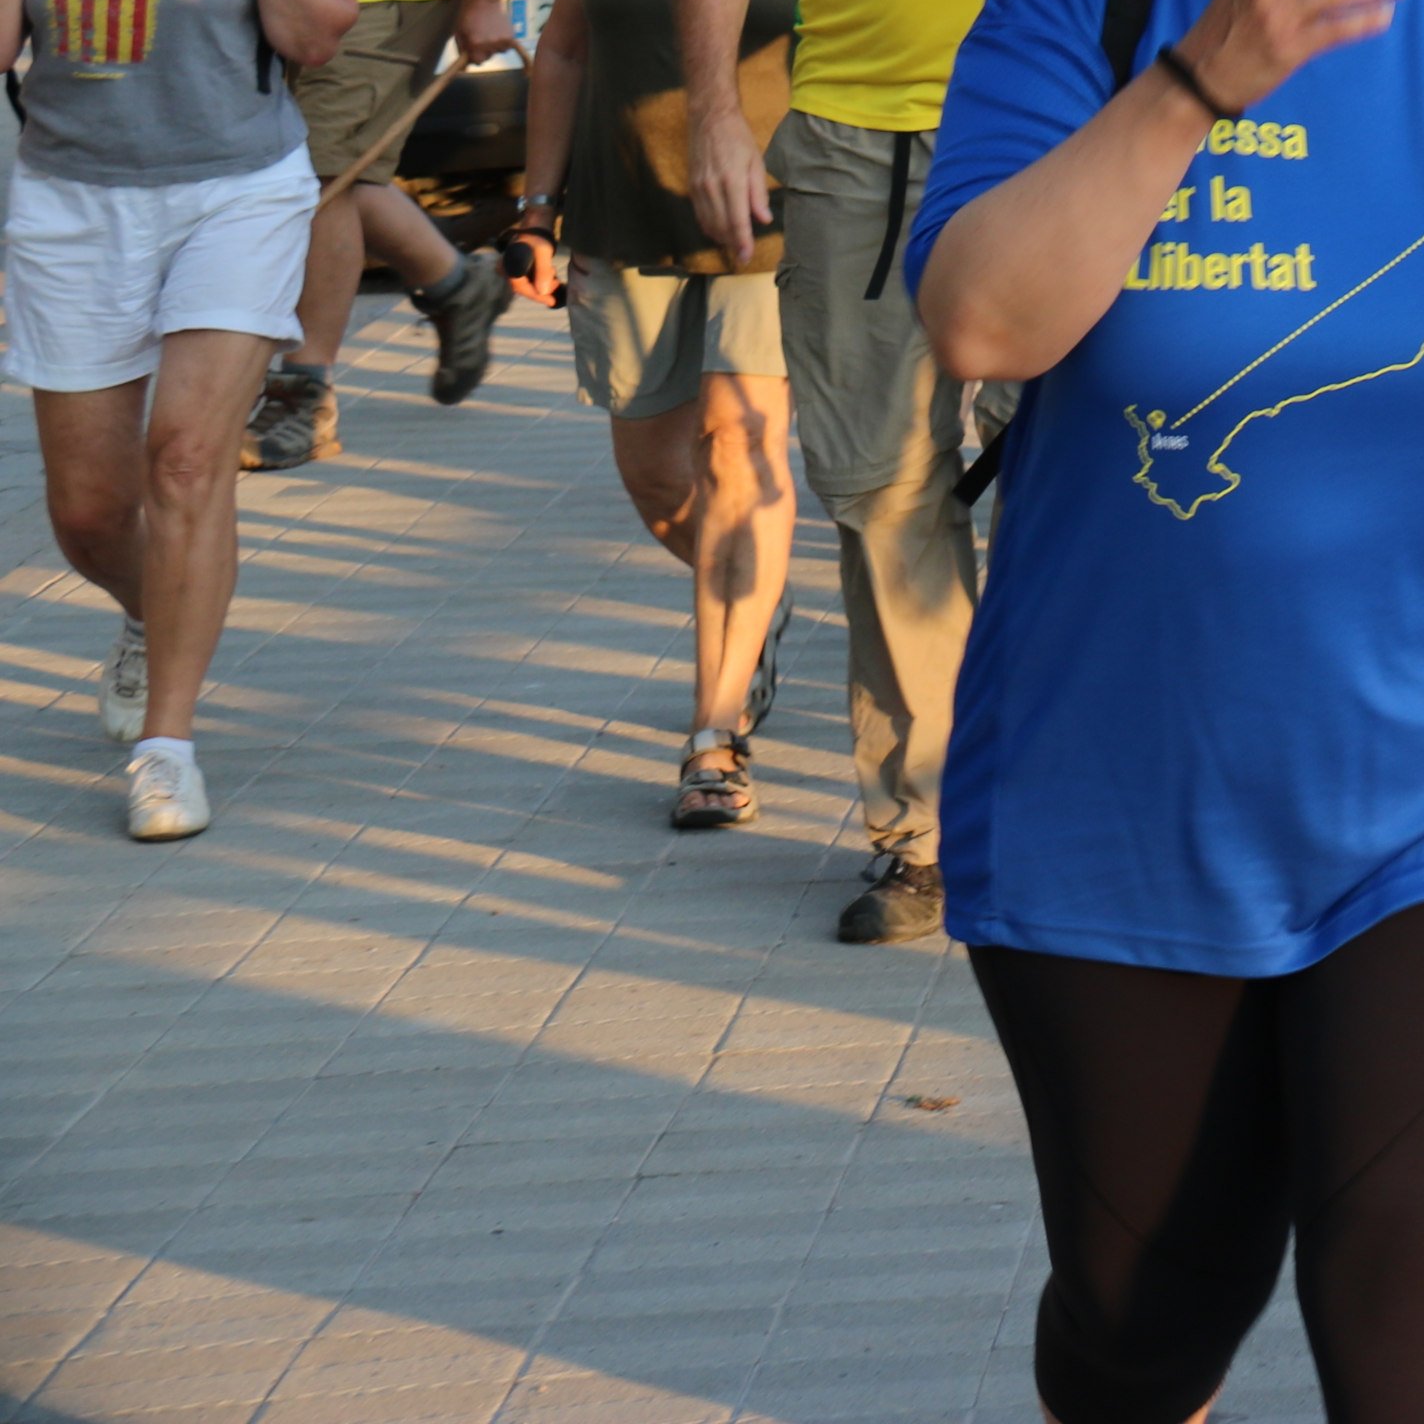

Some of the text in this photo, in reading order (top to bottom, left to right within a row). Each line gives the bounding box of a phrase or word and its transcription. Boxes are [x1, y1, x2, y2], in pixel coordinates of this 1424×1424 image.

[1197, 118, 1309, 160] essa
[1209, 175, 1253, 222] la
[1121, 241, 1318, 292] Llibertat
